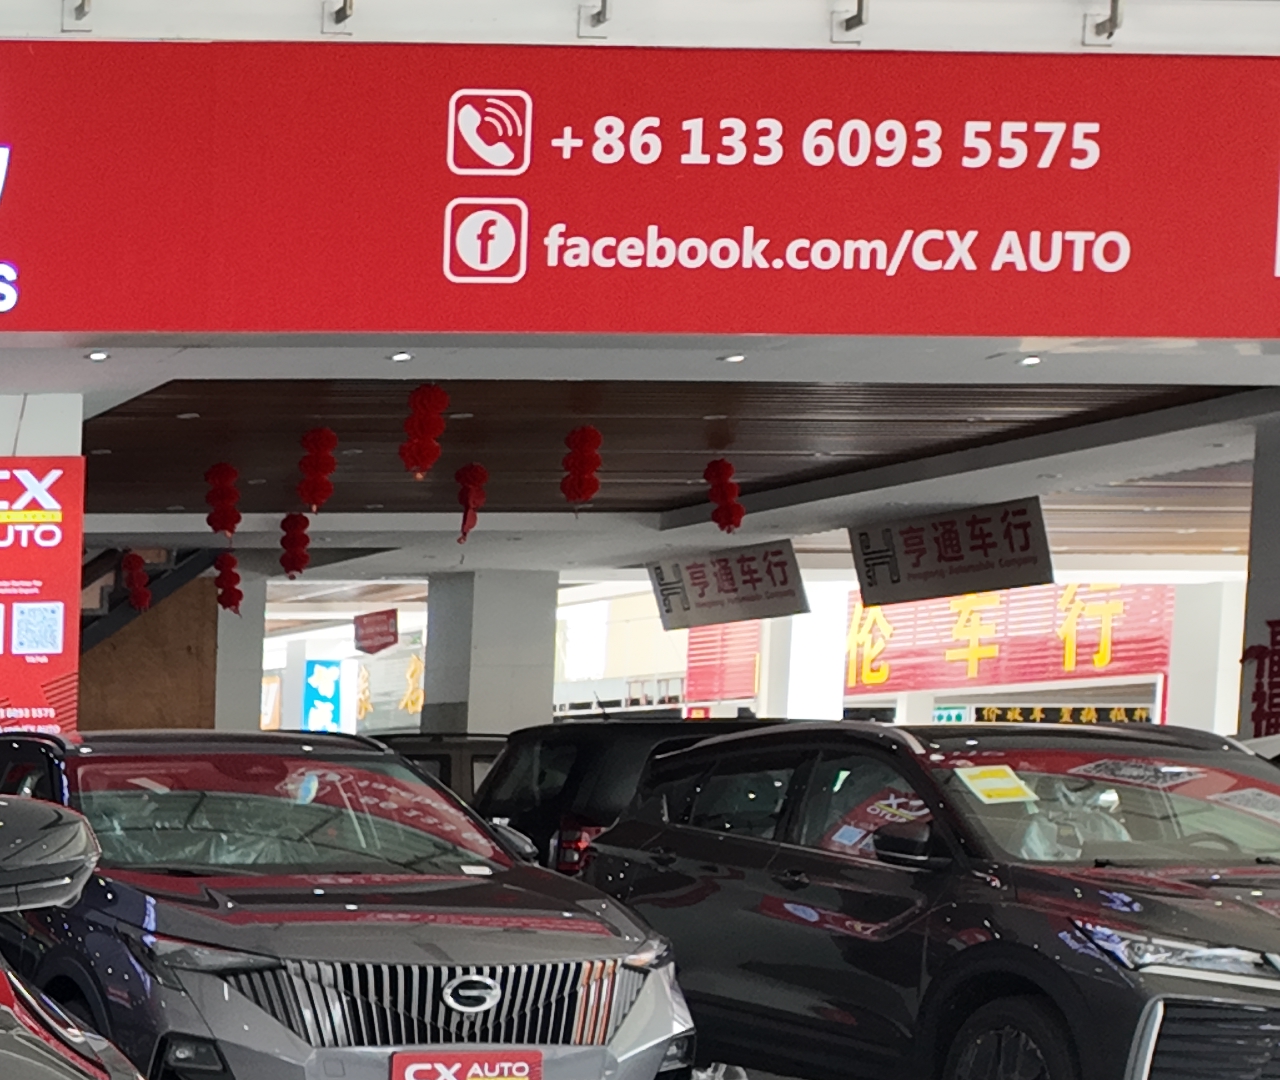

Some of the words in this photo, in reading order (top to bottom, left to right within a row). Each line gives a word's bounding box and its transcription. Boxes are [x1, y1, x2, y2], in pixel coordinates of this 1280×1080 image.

[551, 115, 662, 165] +86
[680, 117, 784, 165] 133
[801, 118, 942, 168] 6093
[961, 120, 1101, 170] 5575
[544, 224, 977, 277] facebook.com/CX
[991, 230, 1131, 273] AUTO
[899, 508, 1032, 568] 亨通车行
[686, 550, 788, 598] 亨通车行
[467, 1061, 530, 1077] AUTO
